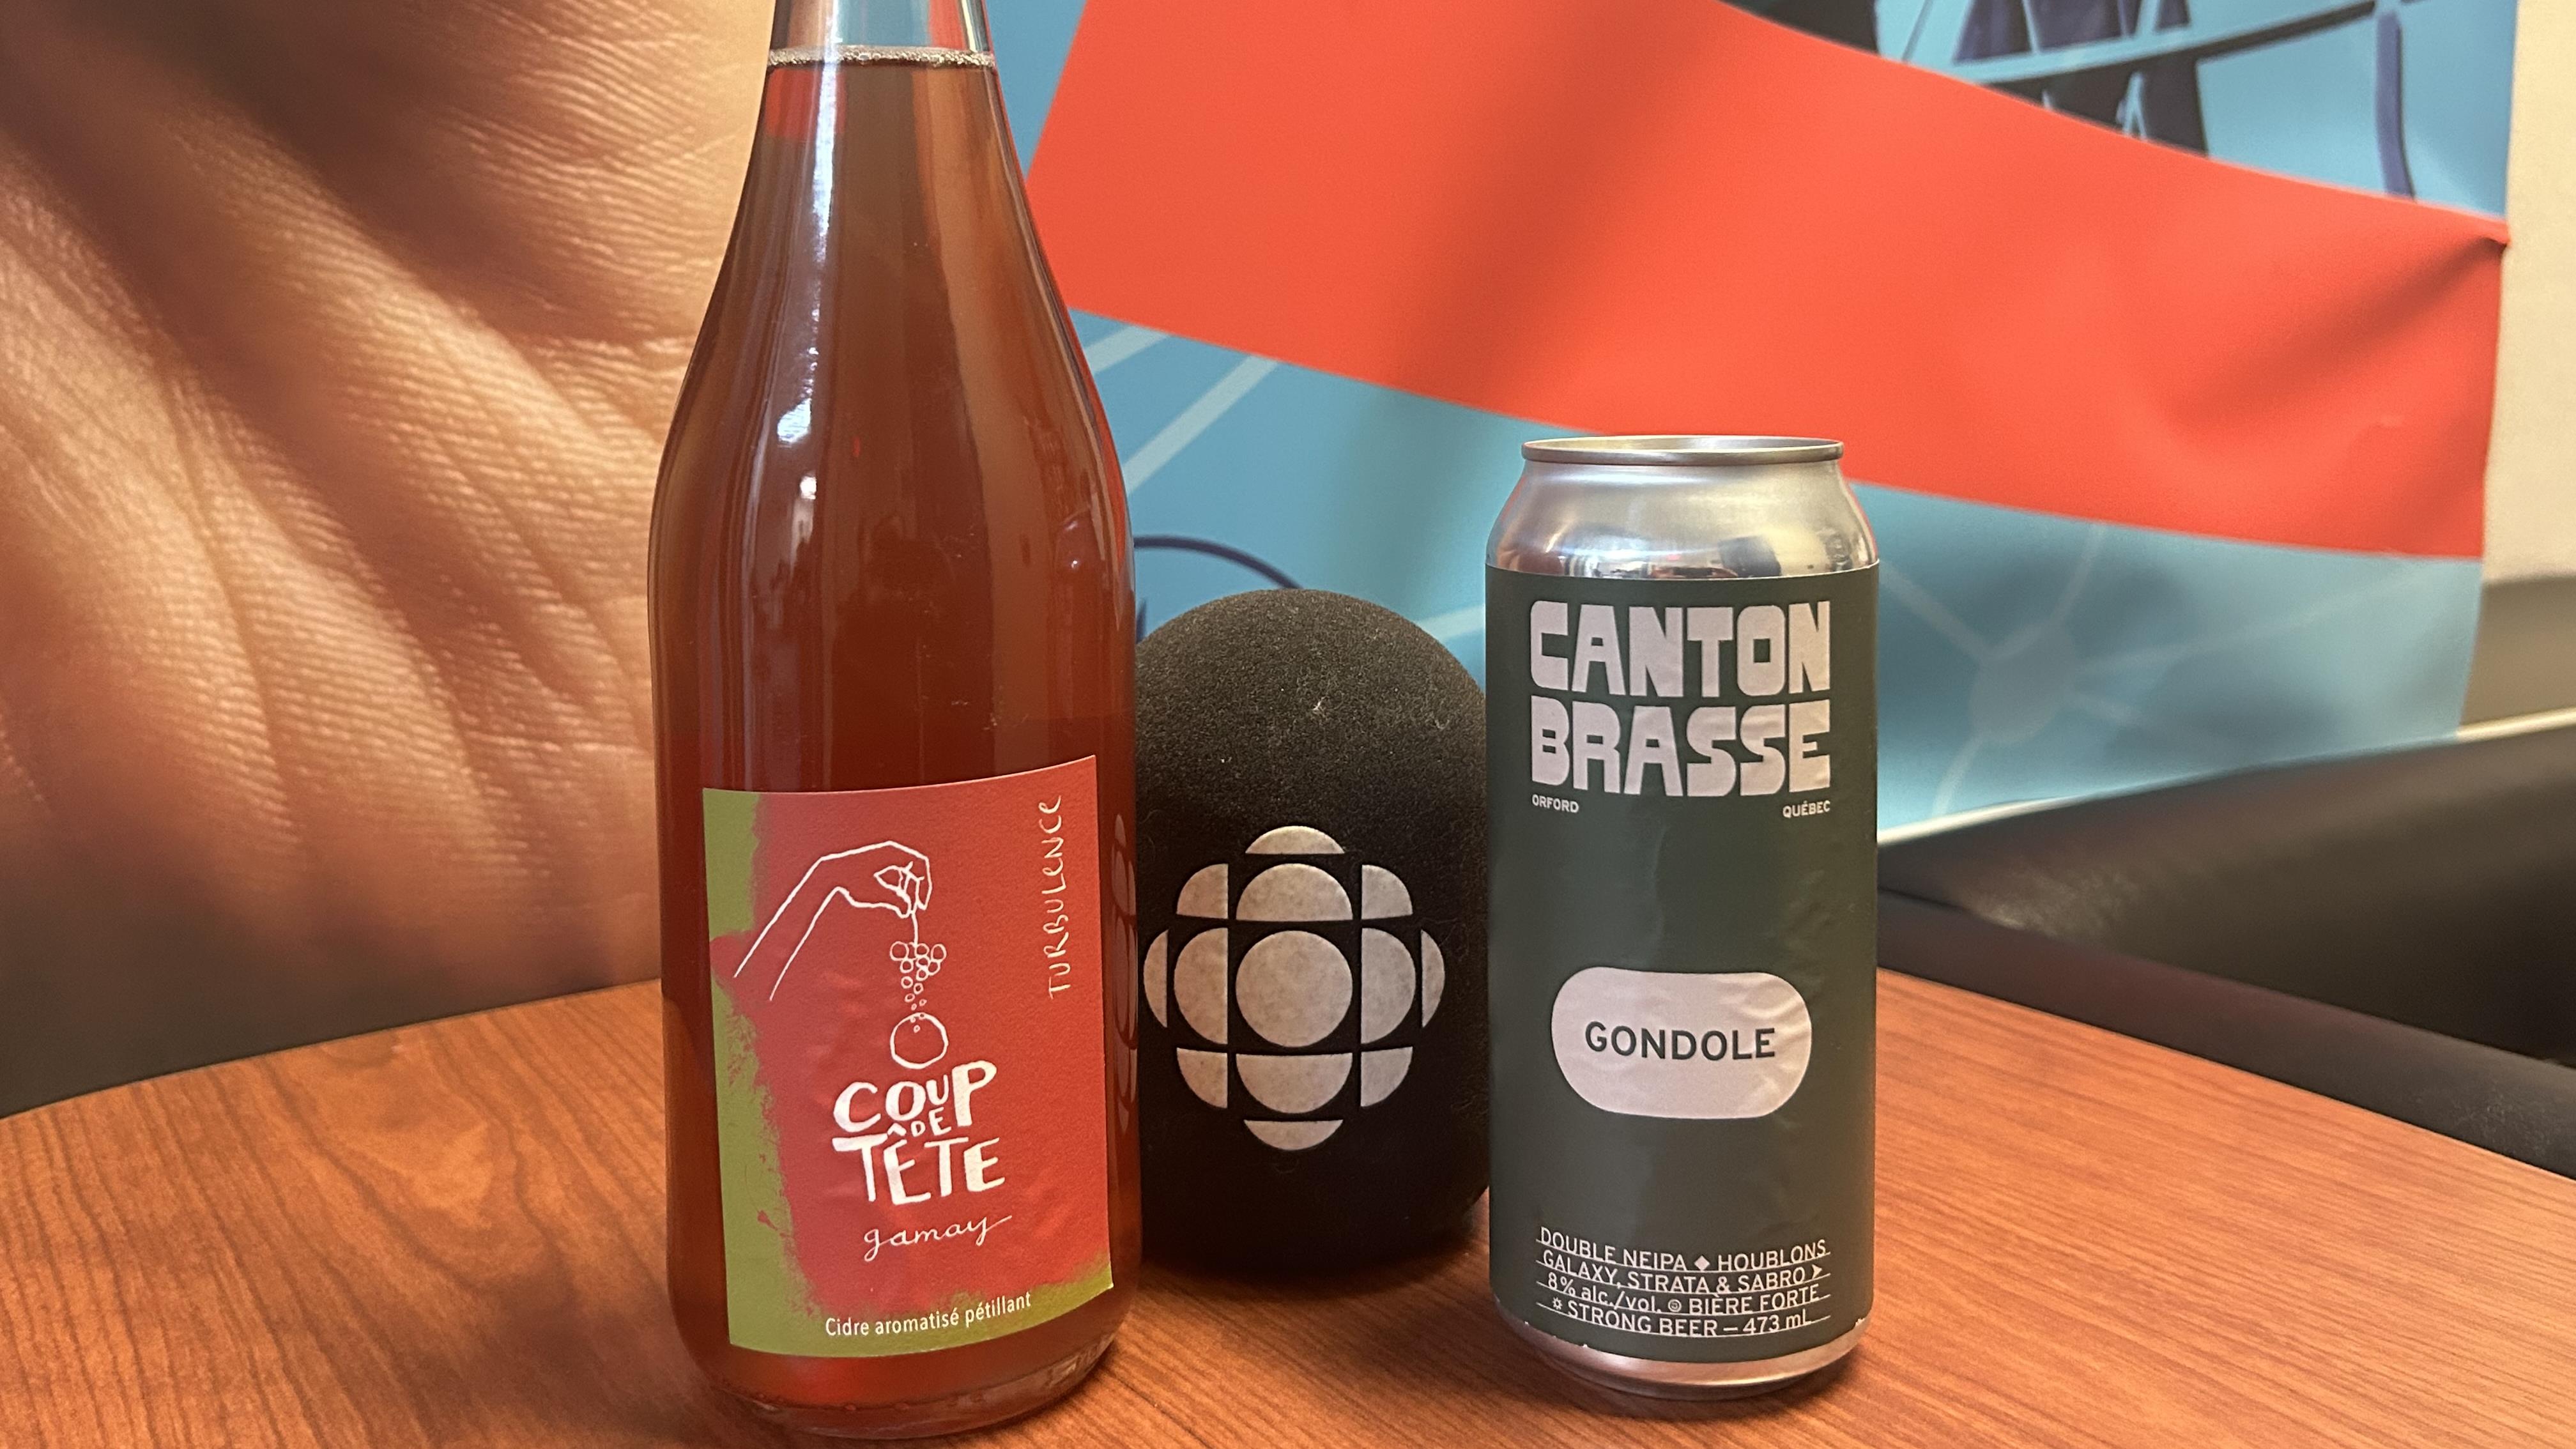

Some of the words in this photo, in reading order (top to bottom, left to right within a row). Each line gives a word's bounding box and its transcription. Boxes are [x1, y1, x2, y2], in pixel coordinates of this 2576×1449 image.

[1530, 601, 1830, 698] CANTON
[1531, 695, 1830, 797] BRASSE
[1532, 794, 1579, 813] ORFORD
[1782, 800, 1830, 819] QUÉBEC
[1038, 795, 1071, 999] TURBULENCE
[1585, 1021, 1775, 1061] GONDOLE
[833, 1060, 997, 1133] COUP
[910, 1107, 952, 1137] DE
[832, 1123, 1006, 1206] TÊTE
[863, 1215, 1013, 1262] gamay
[1540, 1226, 1617, 1264] DOUBLE
[1623, 1248, 1687, 1271] NEIPA
[1717, 1239, 1827, 1271] HOUBLONS
[1543, 1249, 1621, 1290] GALAXY,
[1627, 1270, 1710, 1294] STRATA
[1715, 1275, 1732, 1294] &
[1737, 1266, 1805, 1292] SABRO
[1547, 1271, 1576, 1297] 8%
[1581, 1285, 1662, 1313] alc./vol.
[1689, 1292, 1753, 1315] BIÈRE
[1759, 1283, 1820, 1312] FORTE
[825, 1317, 870, 1337] Cidre
[875, 1307, 960, 1335] aromatisé
[965, 1291, 1031, 1328] pétillant
[1567, 1299, 1652, 1333] STRONG
[1659, 1317, 1718, 1337] BEER
[1742, 1314, 1780, 1335] 473
[1786, 1308, 1811, 1330] mL
